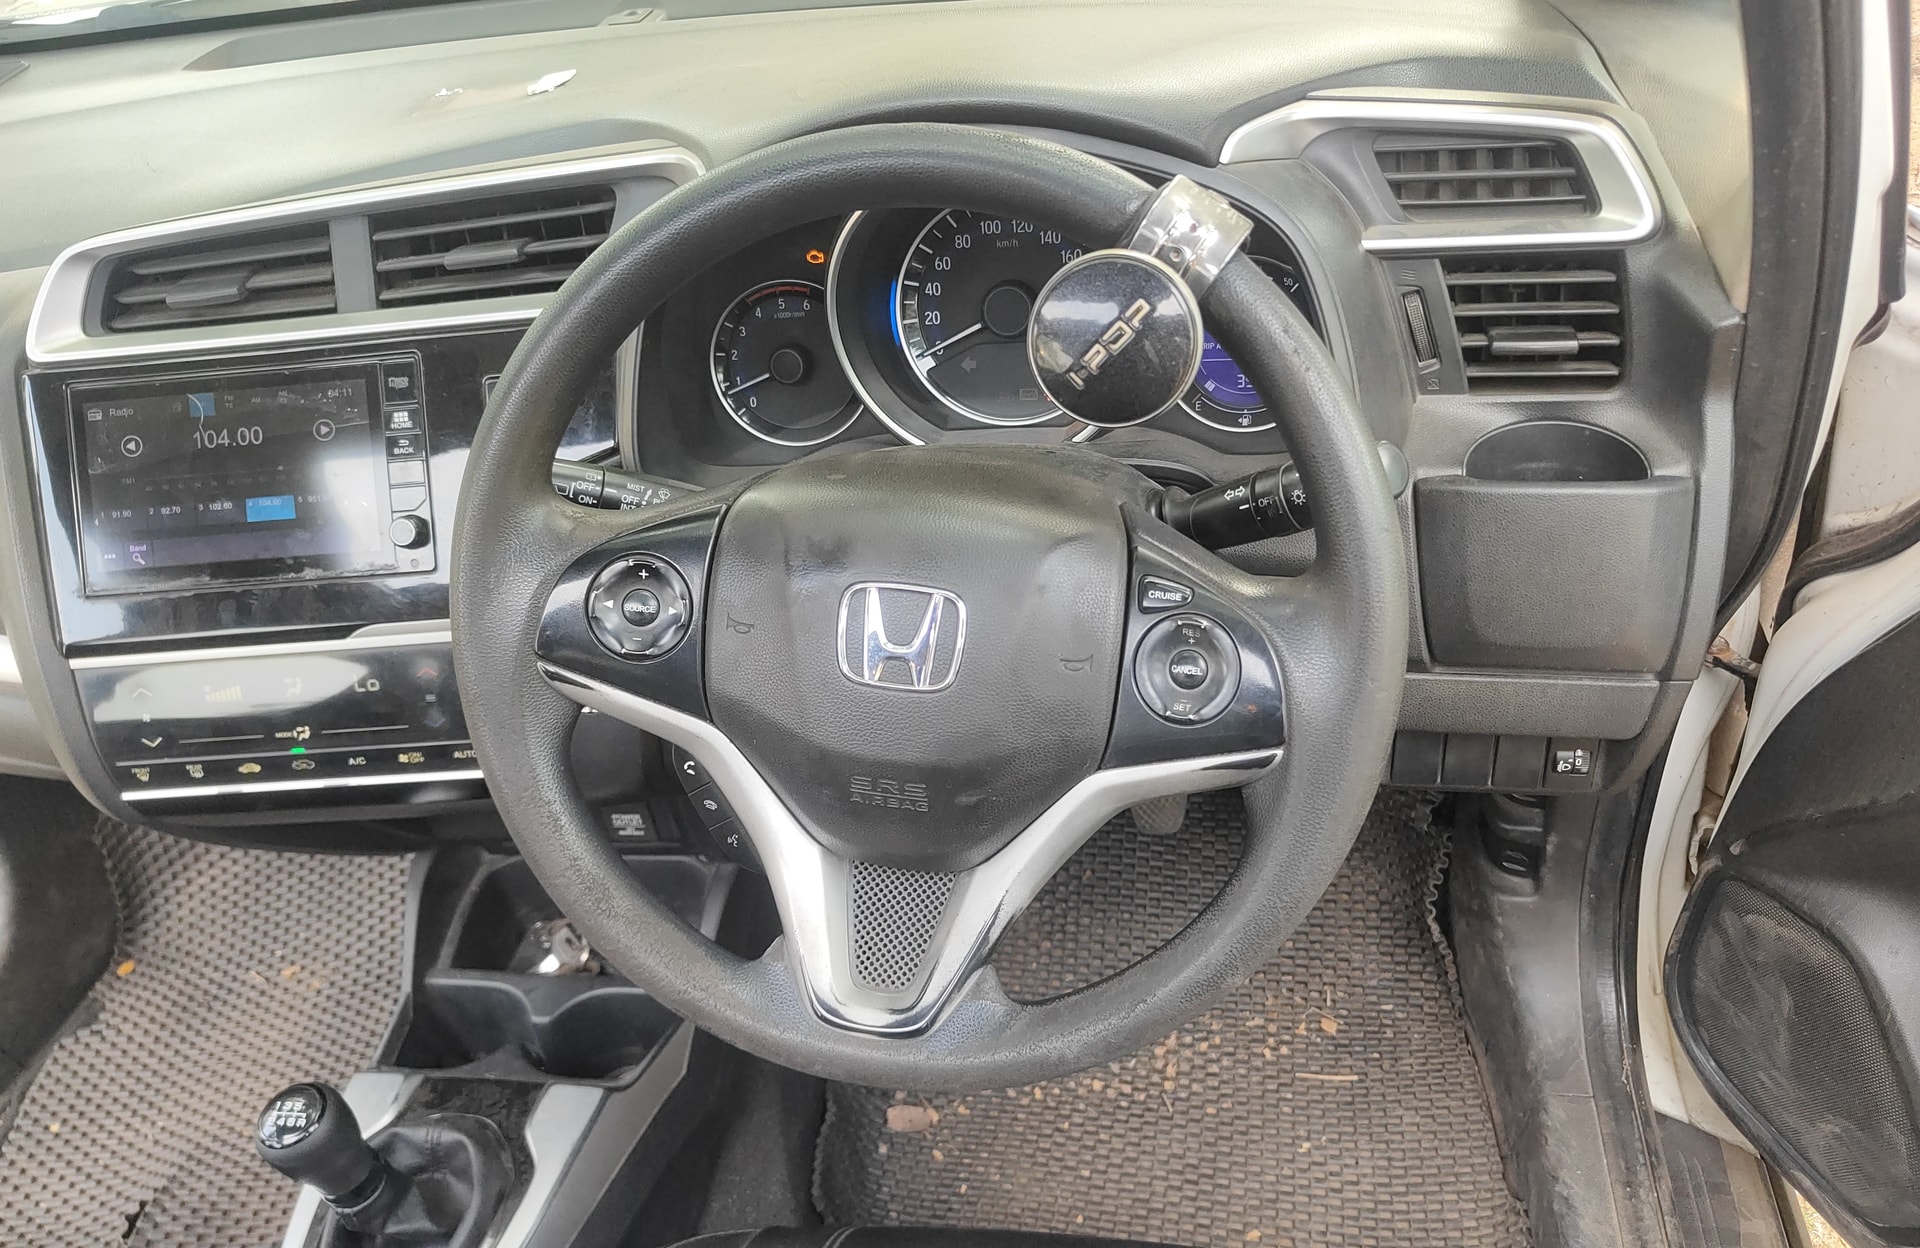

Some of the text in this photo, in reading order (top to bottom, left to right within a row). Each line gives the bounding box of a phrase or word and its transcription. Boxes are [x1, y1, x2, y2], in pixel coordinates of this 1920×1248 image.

[979, 220, 1001, 235] 100
[1011, 219, 1034, 233] 120
[954, 234, 971, 249] 80
[1039, 230, 1061, 245] 140
[996, 239, 1019, 249] km/h
[1060, 249, 1083, 264] 160
[934, 256, 951, 271] 60
[1283, 277, 1294, 286] 50
[925, 282, 941, 296] 40
[778, 298, 785, 310] 5
[803, 299, 810, 311] 6
[755, 307, 762, 318] 4
[924, 311, 941, 325] 20
[739, 326, 746, 337] 3
[1203, 342, 1214, 350] RIP
[731, 350, 738, 361] 2
[735, 376, 741, 386] 1
[328, 388, 352, 398] 04:11
[749, 397, 757, 407] 0
[1195, 401, 1202, 411] E
[391, 421, 414, 430] HOME
[192, 426, 263, 449] 104.00
[393, 447, 415, 455] BACK
[576, 480, 596, 492] OFF
[626, 482, 645, 493] MIST
[578, 495, 593, 505] ON
[621, 494, 640, 505] OFF
[149, 506, 181, 515] 2 92.70
[1148, 590, 1183, 602] CRUISE
[624, 602, 656, 614] SOURCE
[1182, 627, 1201, 638] RES
[1171, 665, 1203, 676] CANCEL
[1173, 702, 1192, 713] SET
[348, 756, 367, 766] A/C
[850, 775, 927, 797] SRS
[849, 793, 929, 812] AIRBAG
